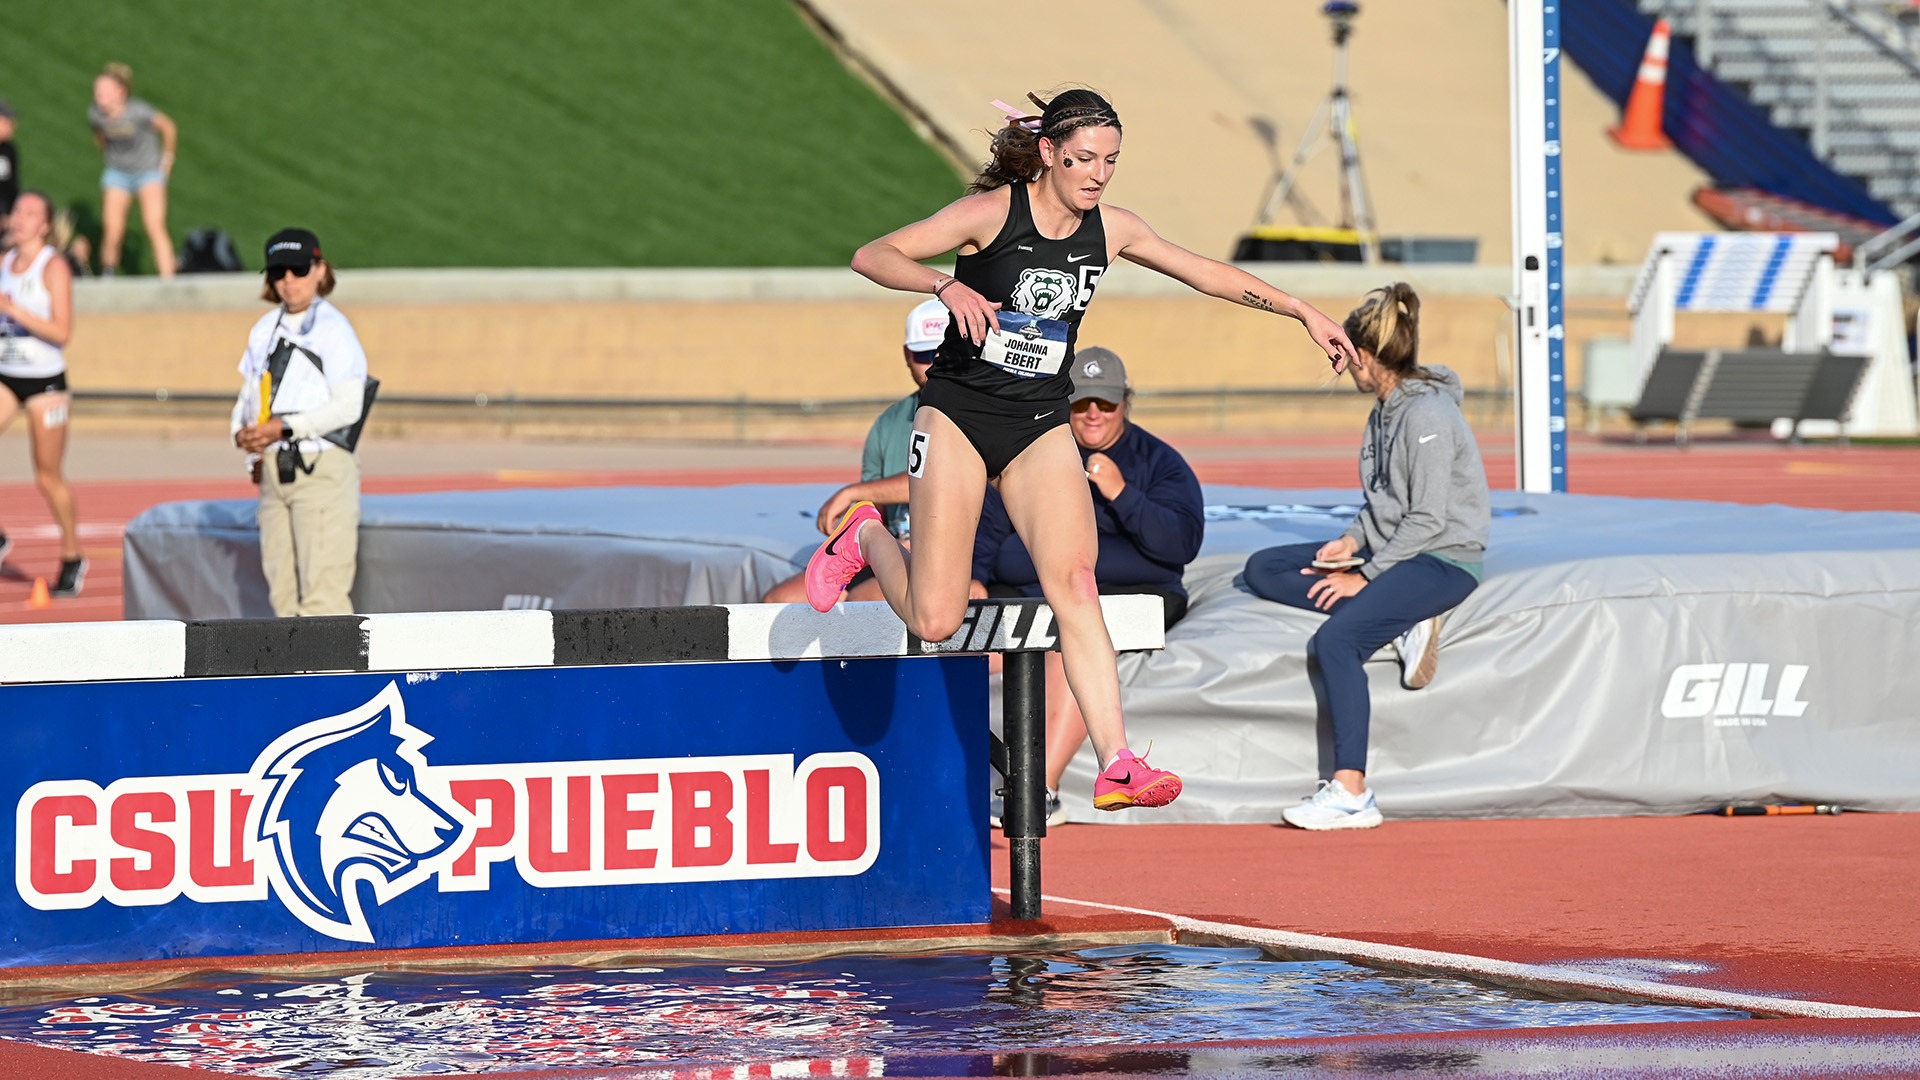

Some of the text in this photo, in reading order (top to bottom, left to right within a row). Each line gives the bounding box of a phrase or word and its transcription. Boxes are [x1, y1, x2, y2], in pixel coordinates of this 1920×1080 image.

[1079, 269, 1101, 307] 5
[1003, 350, 1042, 370] EBERT
[1004, 338, 1048, 356] JOHANNA
[909, 433, 926, 474] 5
[1661, 663, 1809, 718] GILL
[1713, 717, 1740, 727] MADE
[30, 766, 867, 894] CSU PUEBLO
